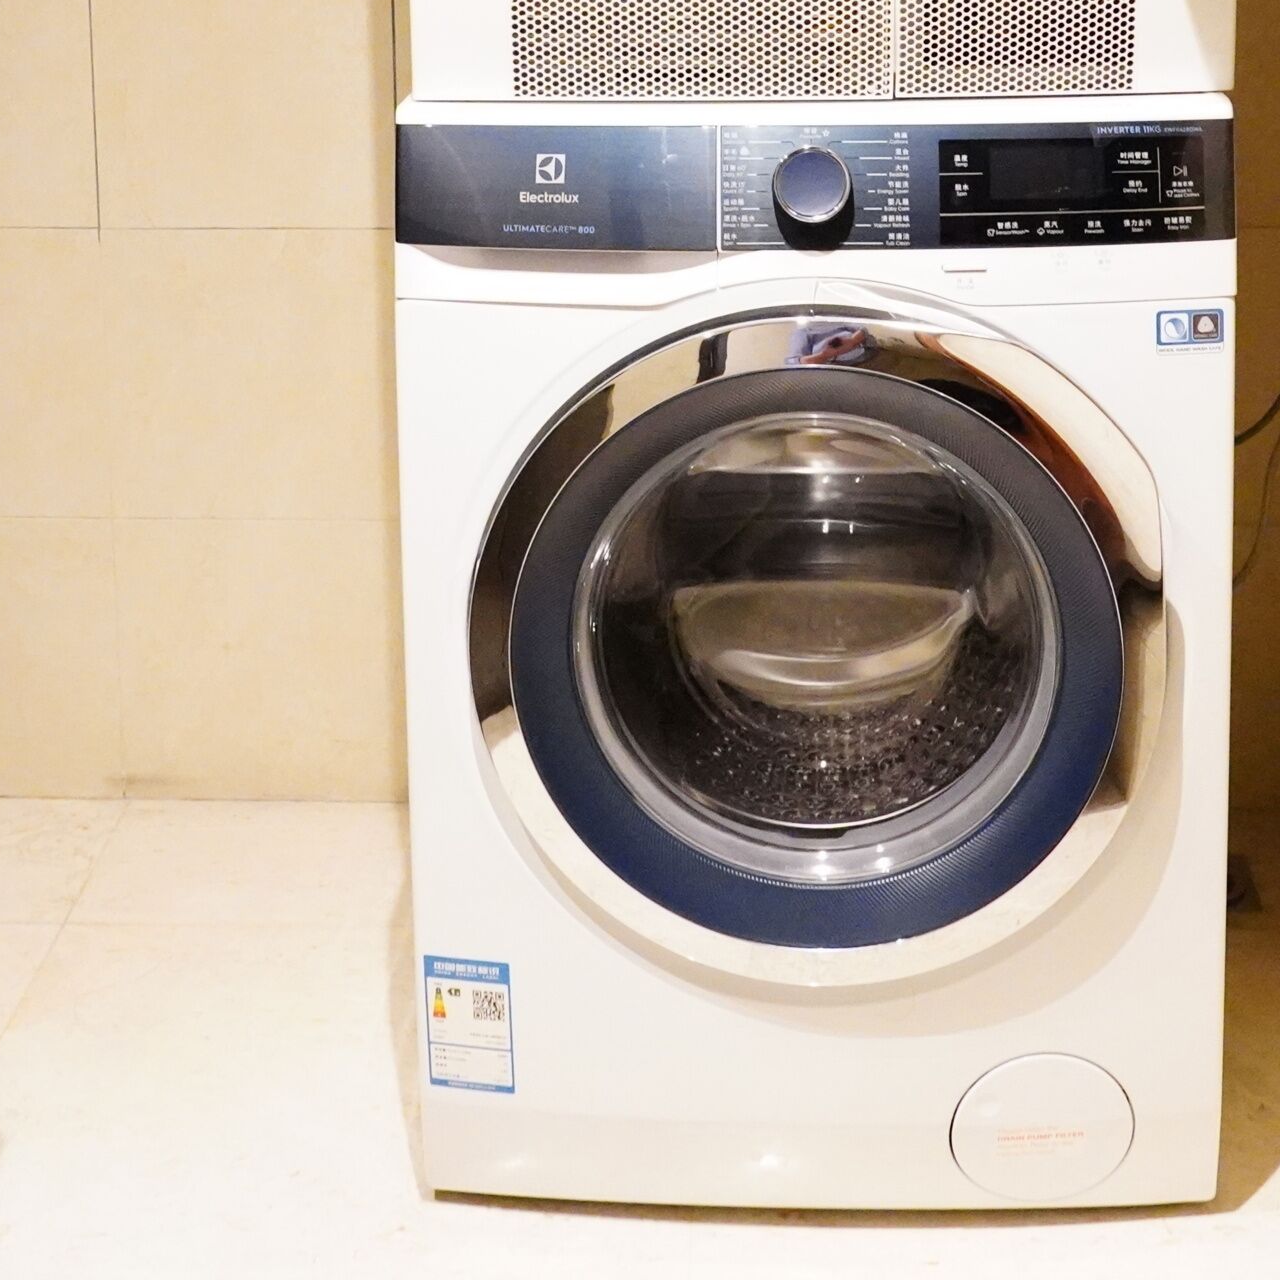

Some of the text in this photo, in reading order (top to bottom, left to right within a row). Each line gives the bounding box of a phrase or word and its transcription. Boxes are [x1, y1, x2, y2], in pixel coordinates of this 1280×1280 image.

[1097, 126, 1141, 134] INVERTER
[1143, 125, 1161, 133] 11KG
[954, 154, 968, 162] 温度
[1120, 151, 1149, 159] 时间管理
[955, 183, 969, 191] 脱水
[519, 191, 579, 204] Electrolux
[997, 221, 1018, 229] 智感洗
[1087, 220, 1102, 228] 预洗
[1123, 219, 1152, 227] 强力去污
[578, 225, 596, 234] 800
